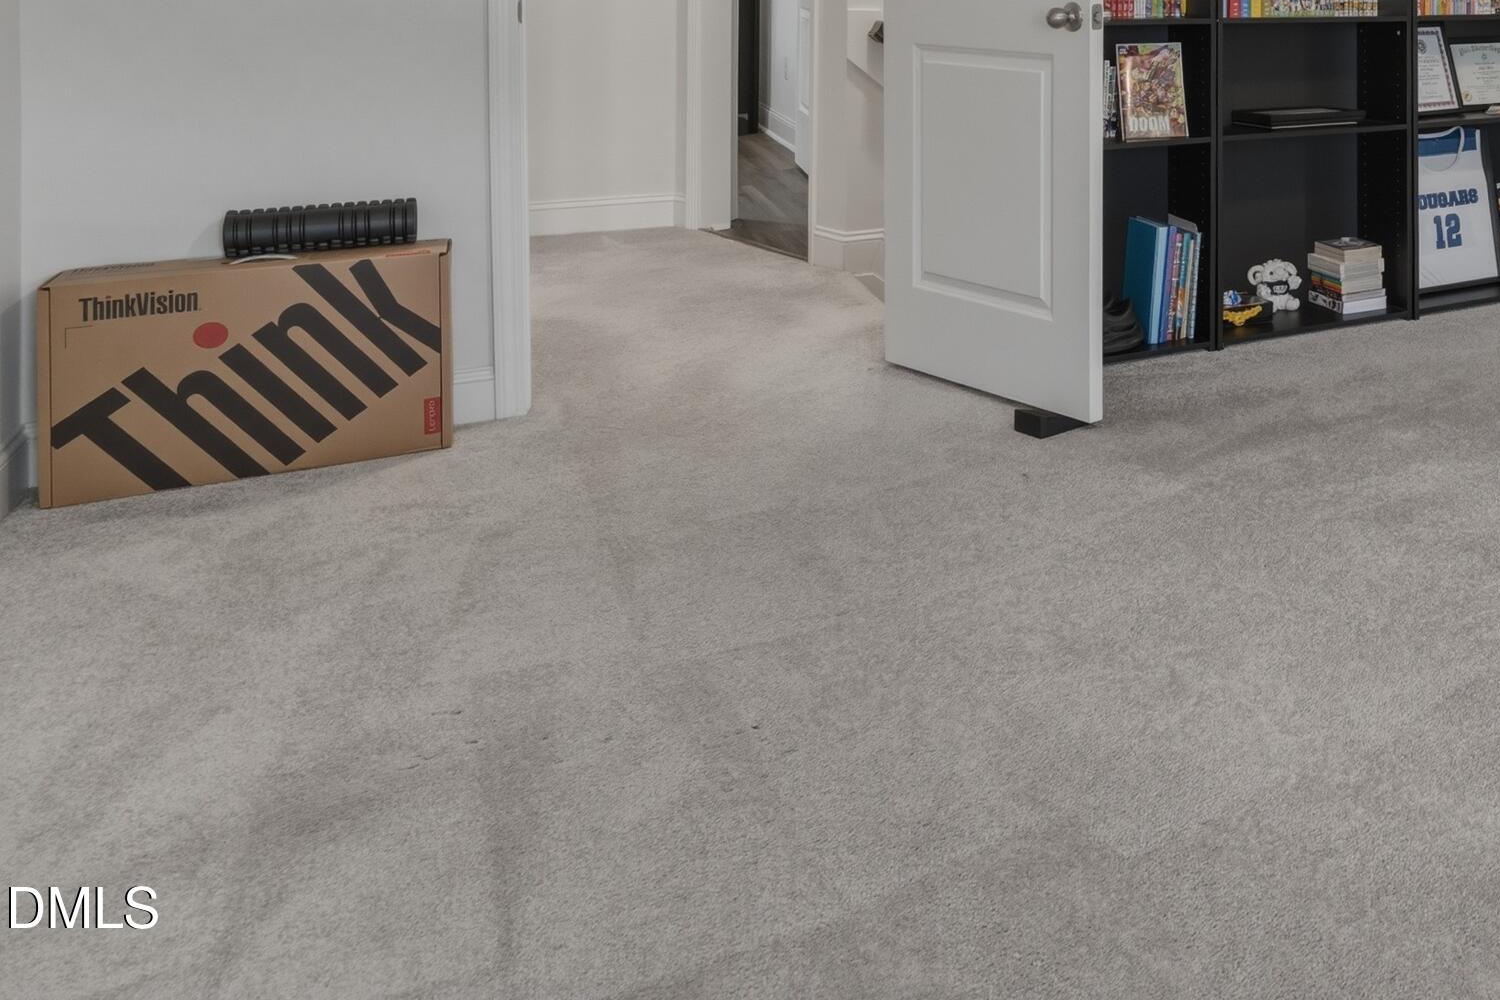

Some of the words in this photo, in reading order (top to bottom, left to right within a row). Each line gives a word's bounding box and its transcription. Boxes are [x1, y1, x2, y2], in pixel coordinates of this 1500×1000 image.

[1418, 188, 1479, 210] OUGARS
[1434, 213, 1463, 249] 12
[79, 290, 199, 322] ThinkVision
[51, 259, 442, 491] Think
